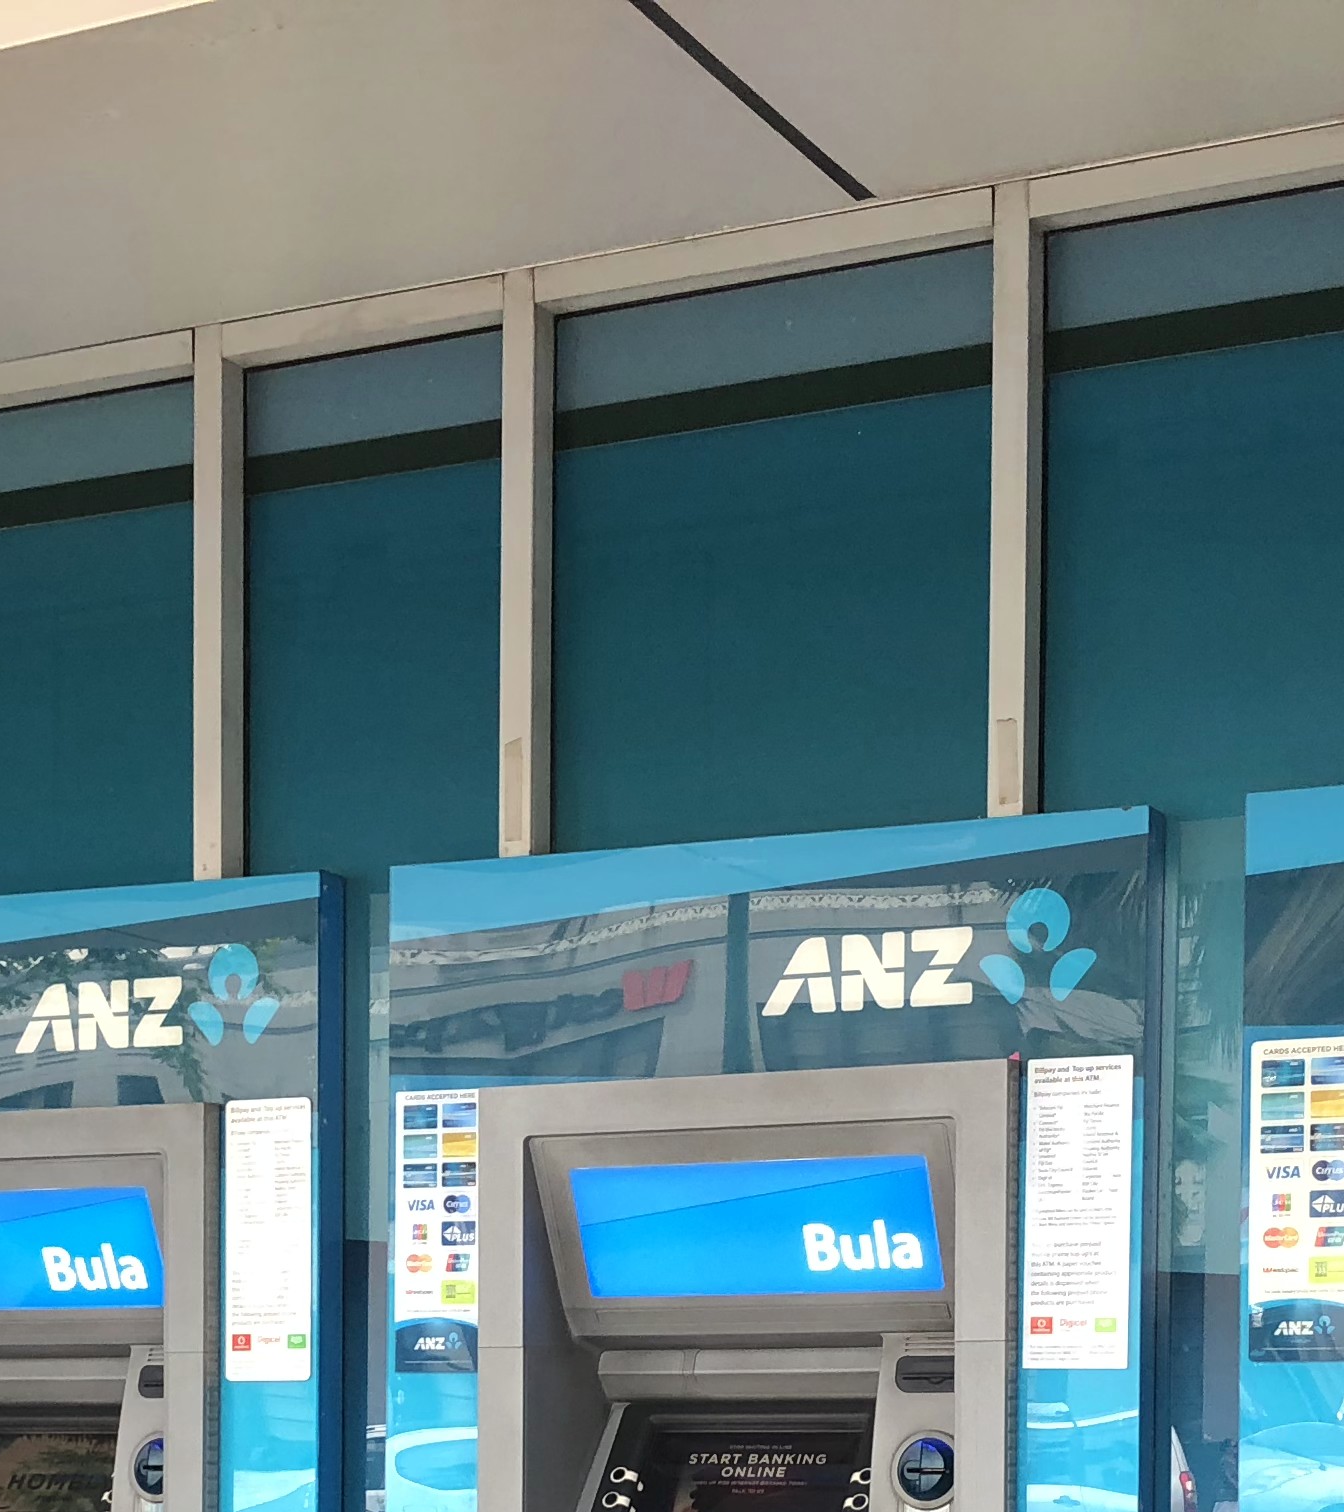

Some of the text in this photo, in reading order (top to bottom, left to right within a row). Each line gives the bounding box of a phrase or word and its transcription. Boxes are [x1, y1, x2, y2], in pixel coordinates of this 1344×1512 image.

[761, 926, 974, 1017] ANZ
[14, 976, 183, 1054] ANZ
[1263, 1047, 1289, 1056] CARDS
[1291, 1045, 1332, 1054] ACCEPTED
[1266, 1165, 1301, 1180] VISA
[1315, 1165, 1344, 1176] Cirrus
[408, 1199, 435, 1211] VISA
[452, 1232, 475, 1242] PLUS
[801, 1220, 924, 1272] Bula
[41, 1243, 148, 1291] Bula
[1273, 1320, 1314, 1336] ANZ
[413, 1336, 445, 1351] ANZ
[688, 1453, 827, 1465] START BANKING
[721, 1466, 787, 1478] ONLINE
